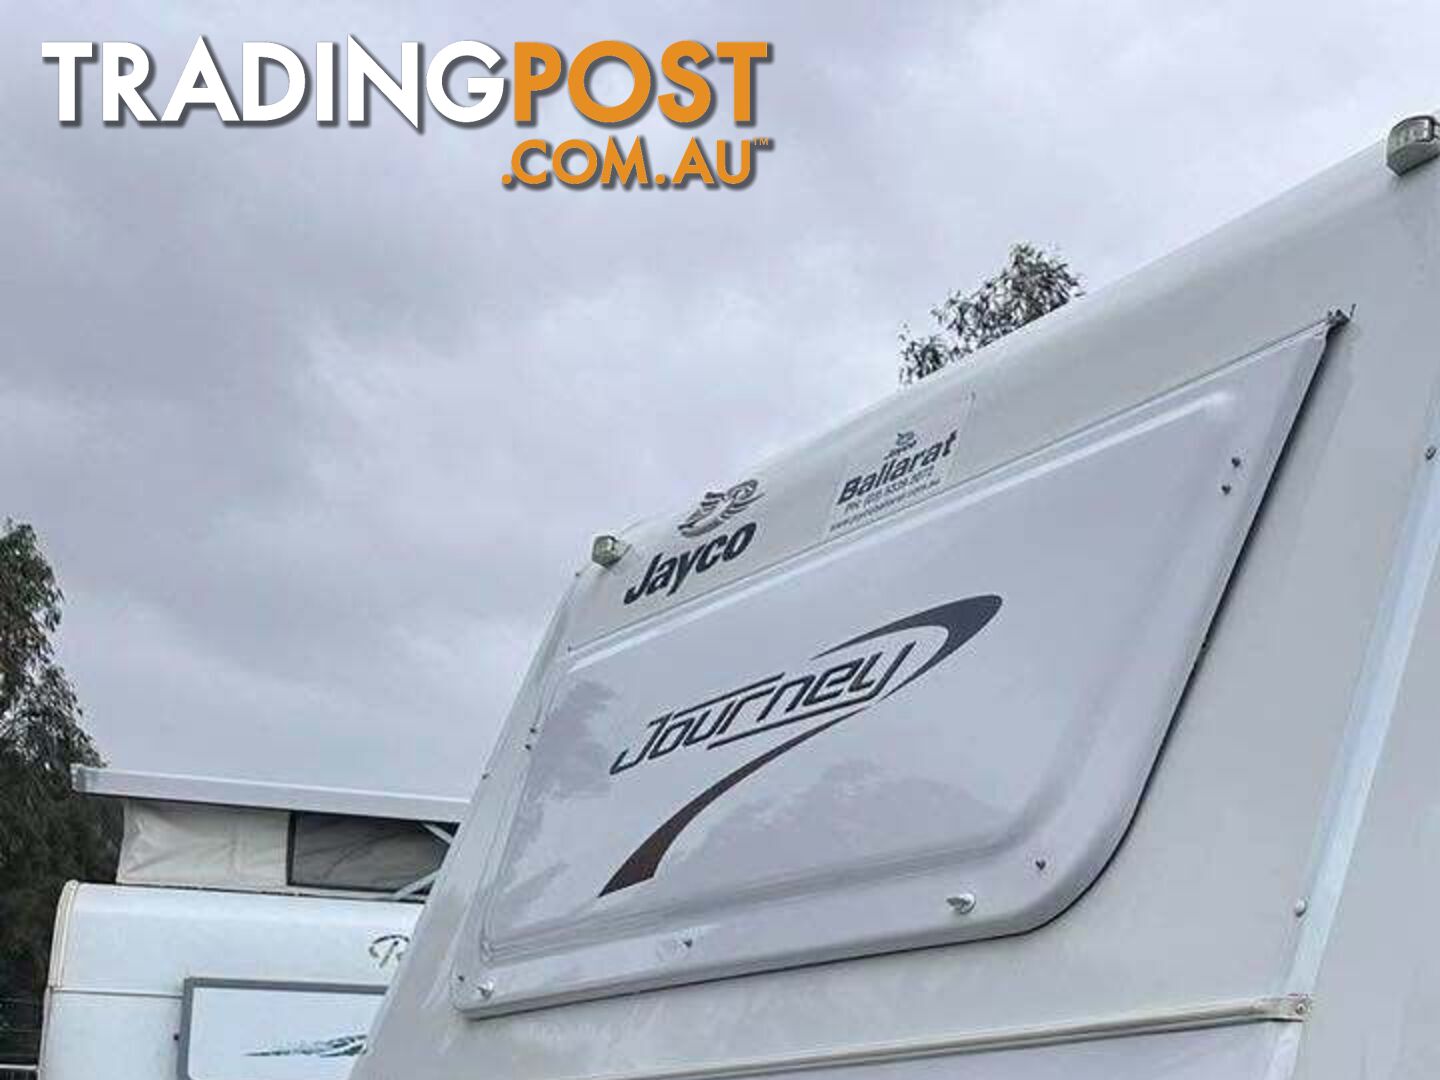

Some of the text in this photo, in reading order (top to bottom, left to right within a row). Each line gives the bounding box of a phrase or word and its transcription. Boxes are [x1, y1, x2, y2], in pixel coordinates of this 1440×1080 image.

[837, 430, 958, 506] Ballarat
[623, 521, 757, 606] Jayco
[610, 640, 916, 776] Journey
